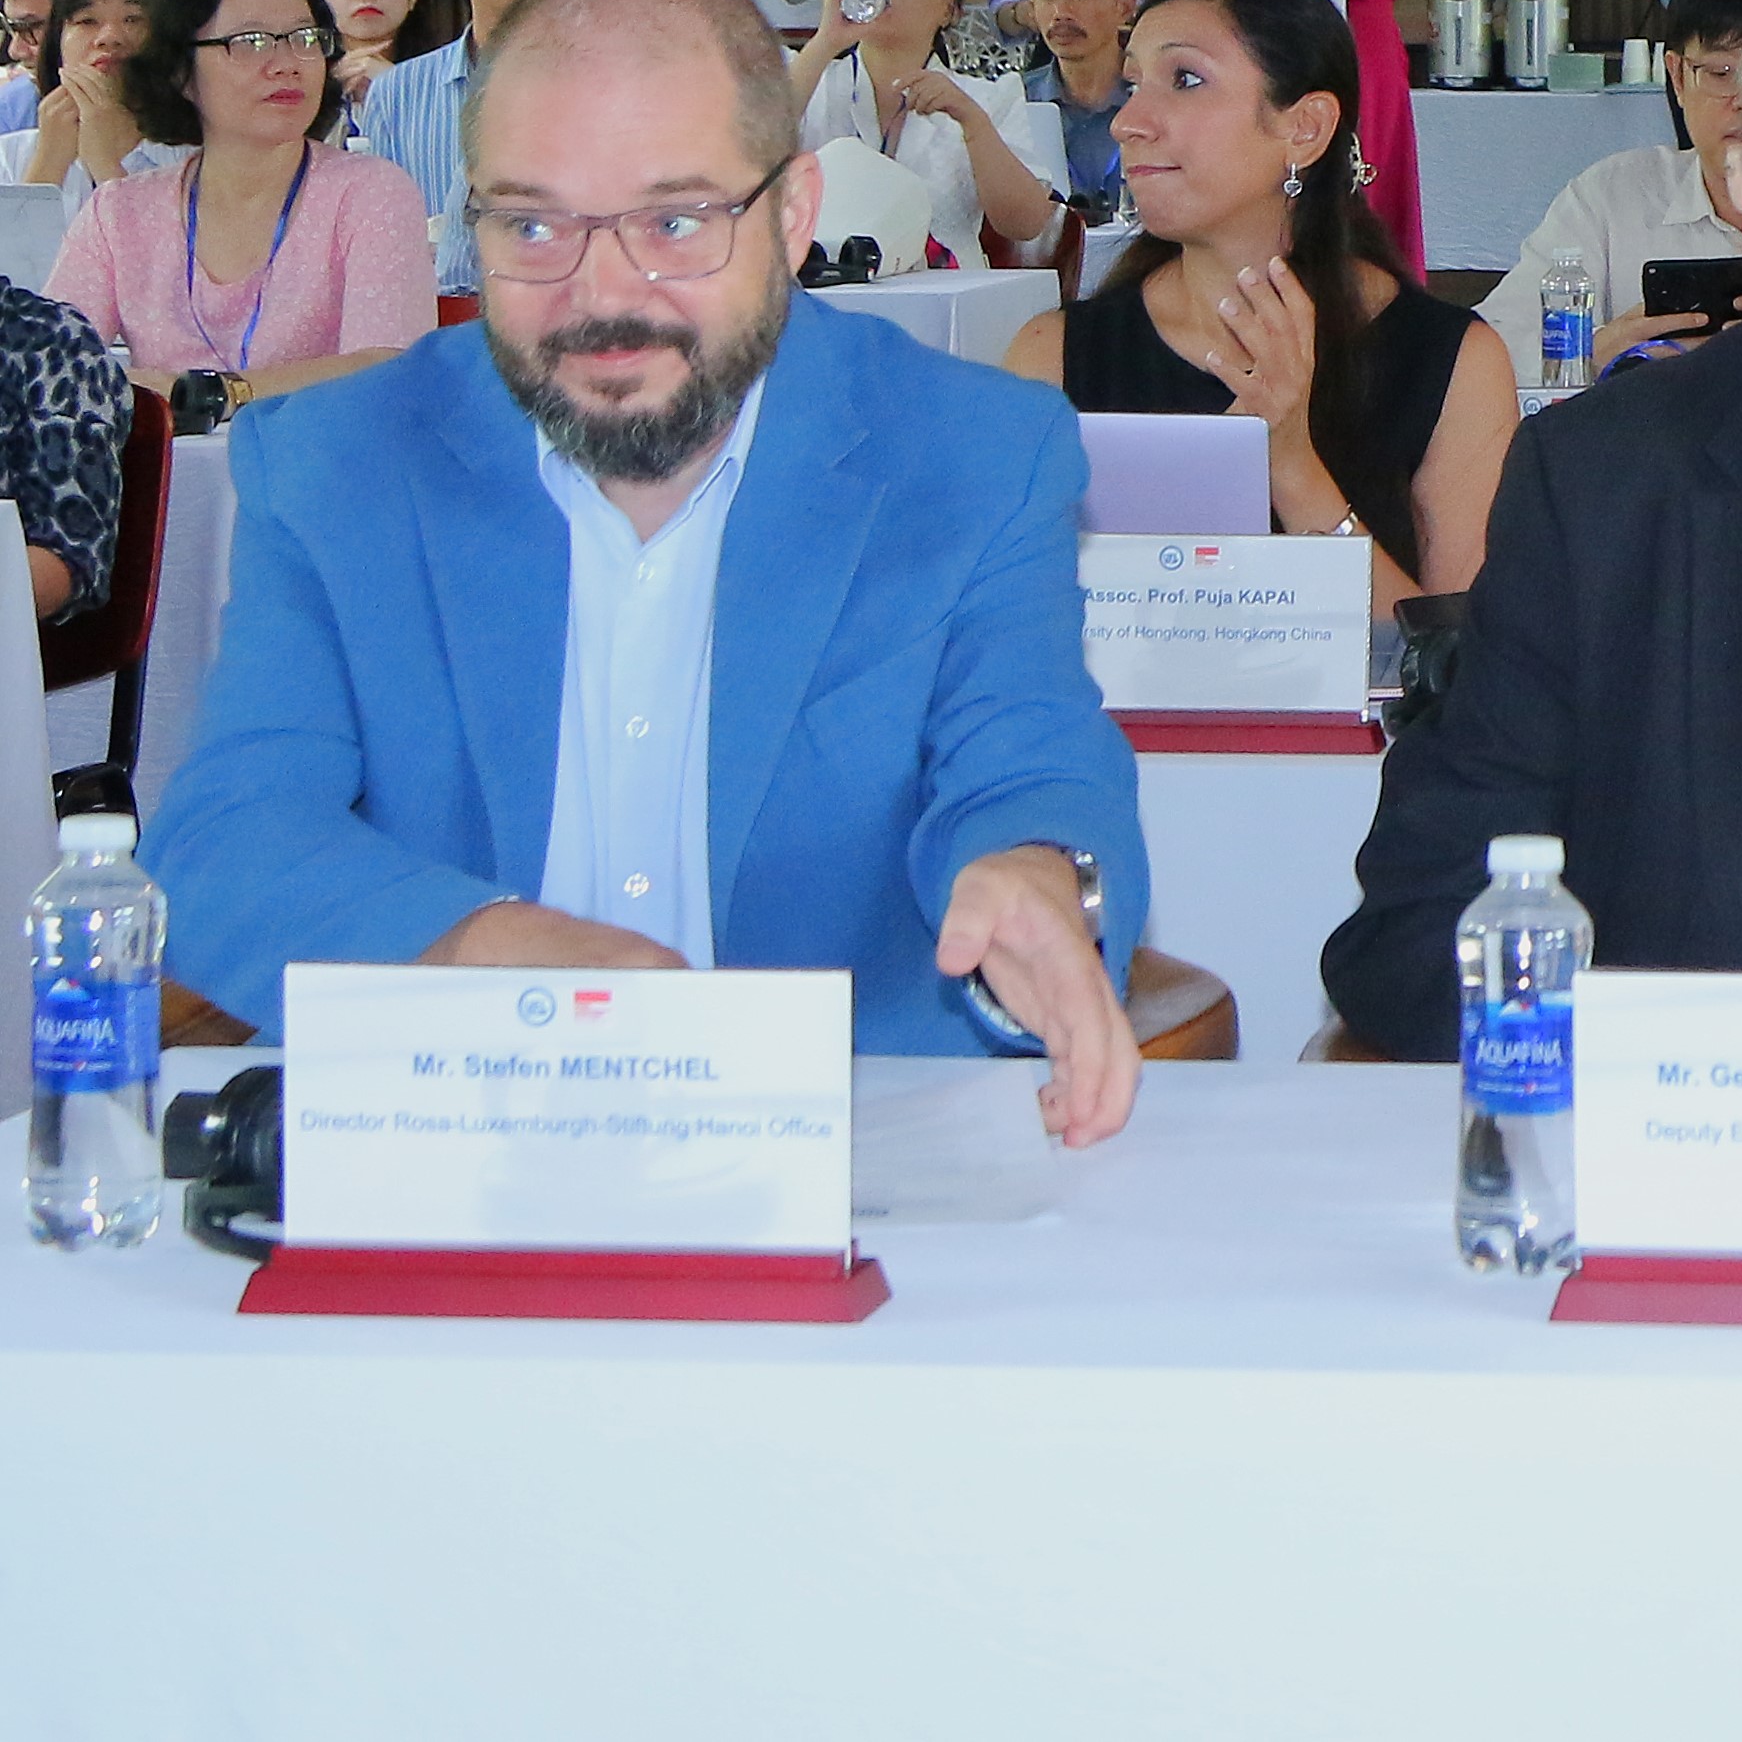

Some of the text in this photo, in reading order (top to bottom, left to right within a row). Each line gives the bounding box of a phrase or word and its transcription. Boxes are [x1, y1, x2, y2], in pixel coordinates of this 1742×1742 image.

[1085, 588, 1297, 607] Assoc. Prof. Puja KAPAI
[1117, 625, 1132, 639] of
[1215, 627, 1286, 642] Hongkong
[1291, 627, 1332, 641] China
[413, 1053, 454, 1077] Mr.
[561, 1055, 719, 1080] MENTCHEL
[1657, 1063, 1700, 1087] Mr.
[300, 1110, 386, 1133] Director
[696, 1116, 760, 1136] Hanoi
[768, 1116, 831, 1138] Office
[1645, 1120, 1724, 1145] Deputy
